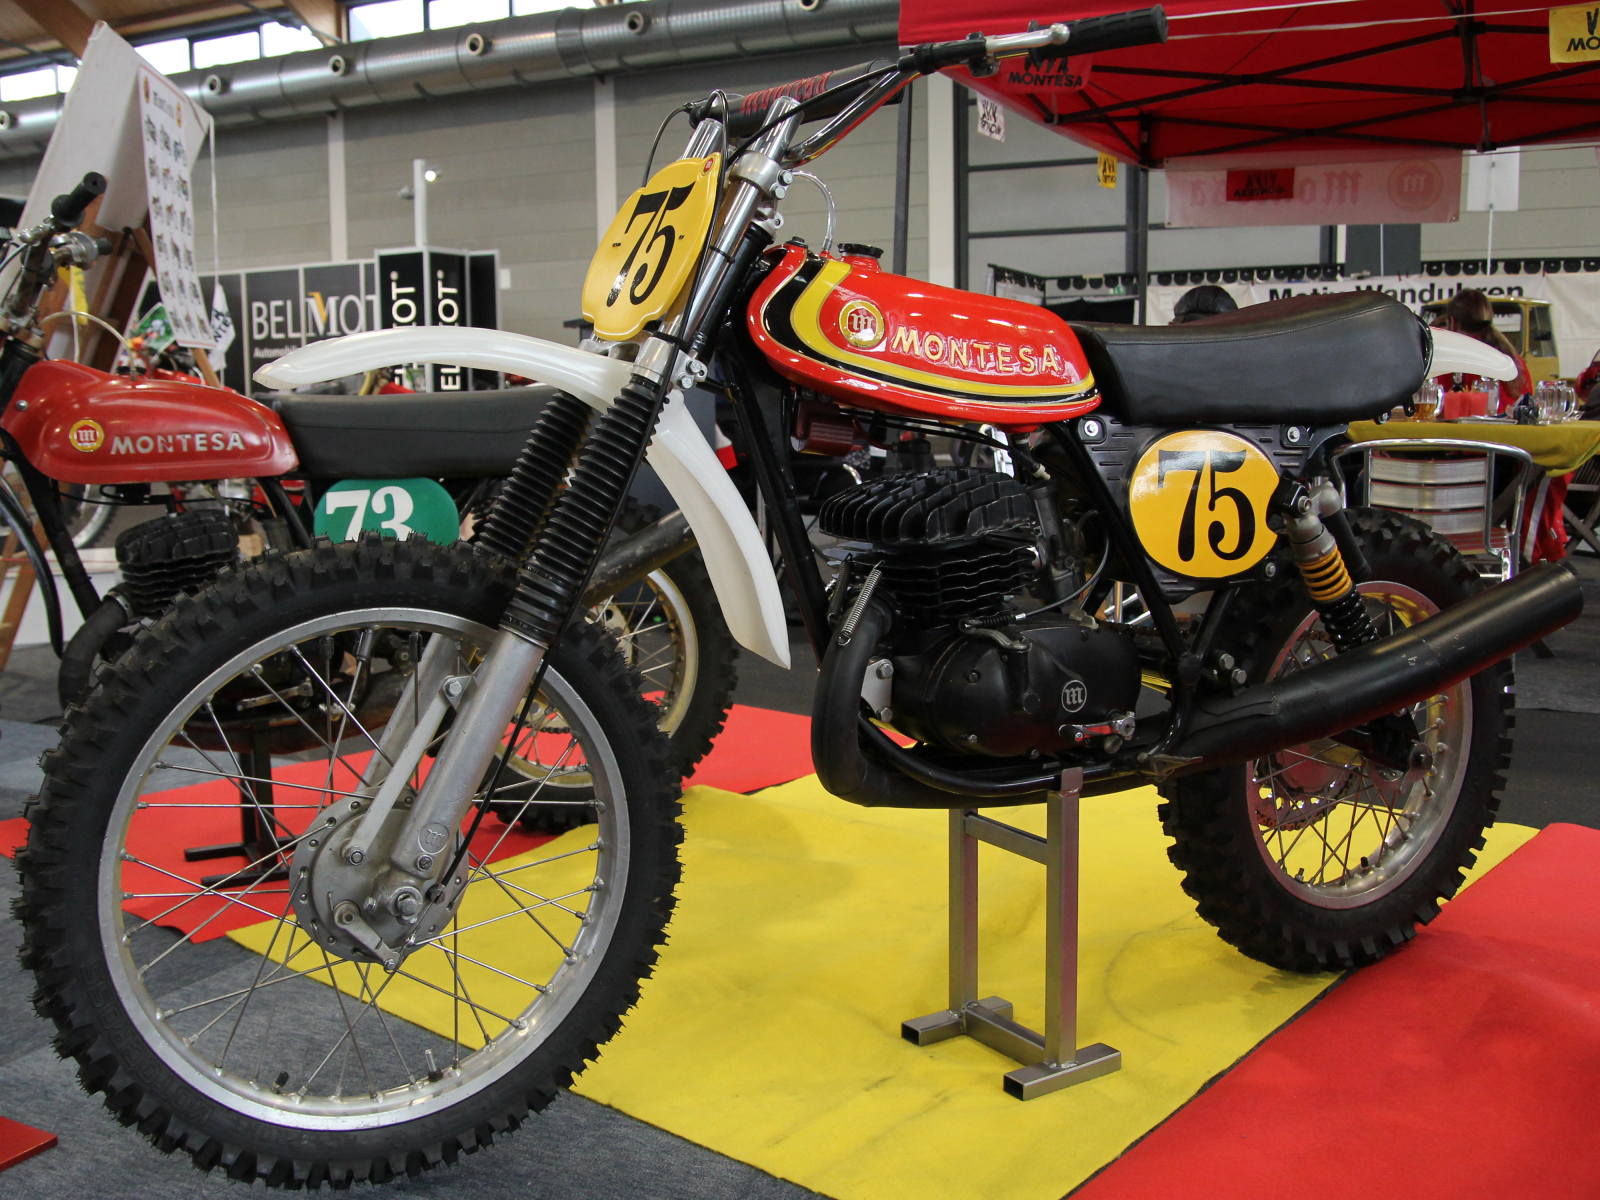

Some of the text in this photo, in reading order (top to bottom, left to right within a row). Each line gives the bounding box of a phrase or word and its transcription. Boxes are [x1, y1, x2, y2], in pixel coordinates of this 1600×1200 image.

[1008, 71, 1083, 88] MONTESA
[606, 181, 696, 308] 75
[892, 325, 1060, 374] MONTESA
[110, 432, 245, 455] MONTESA
[326, 485, 414, 542] 73
[1157, 449, 1256, 563] 75
